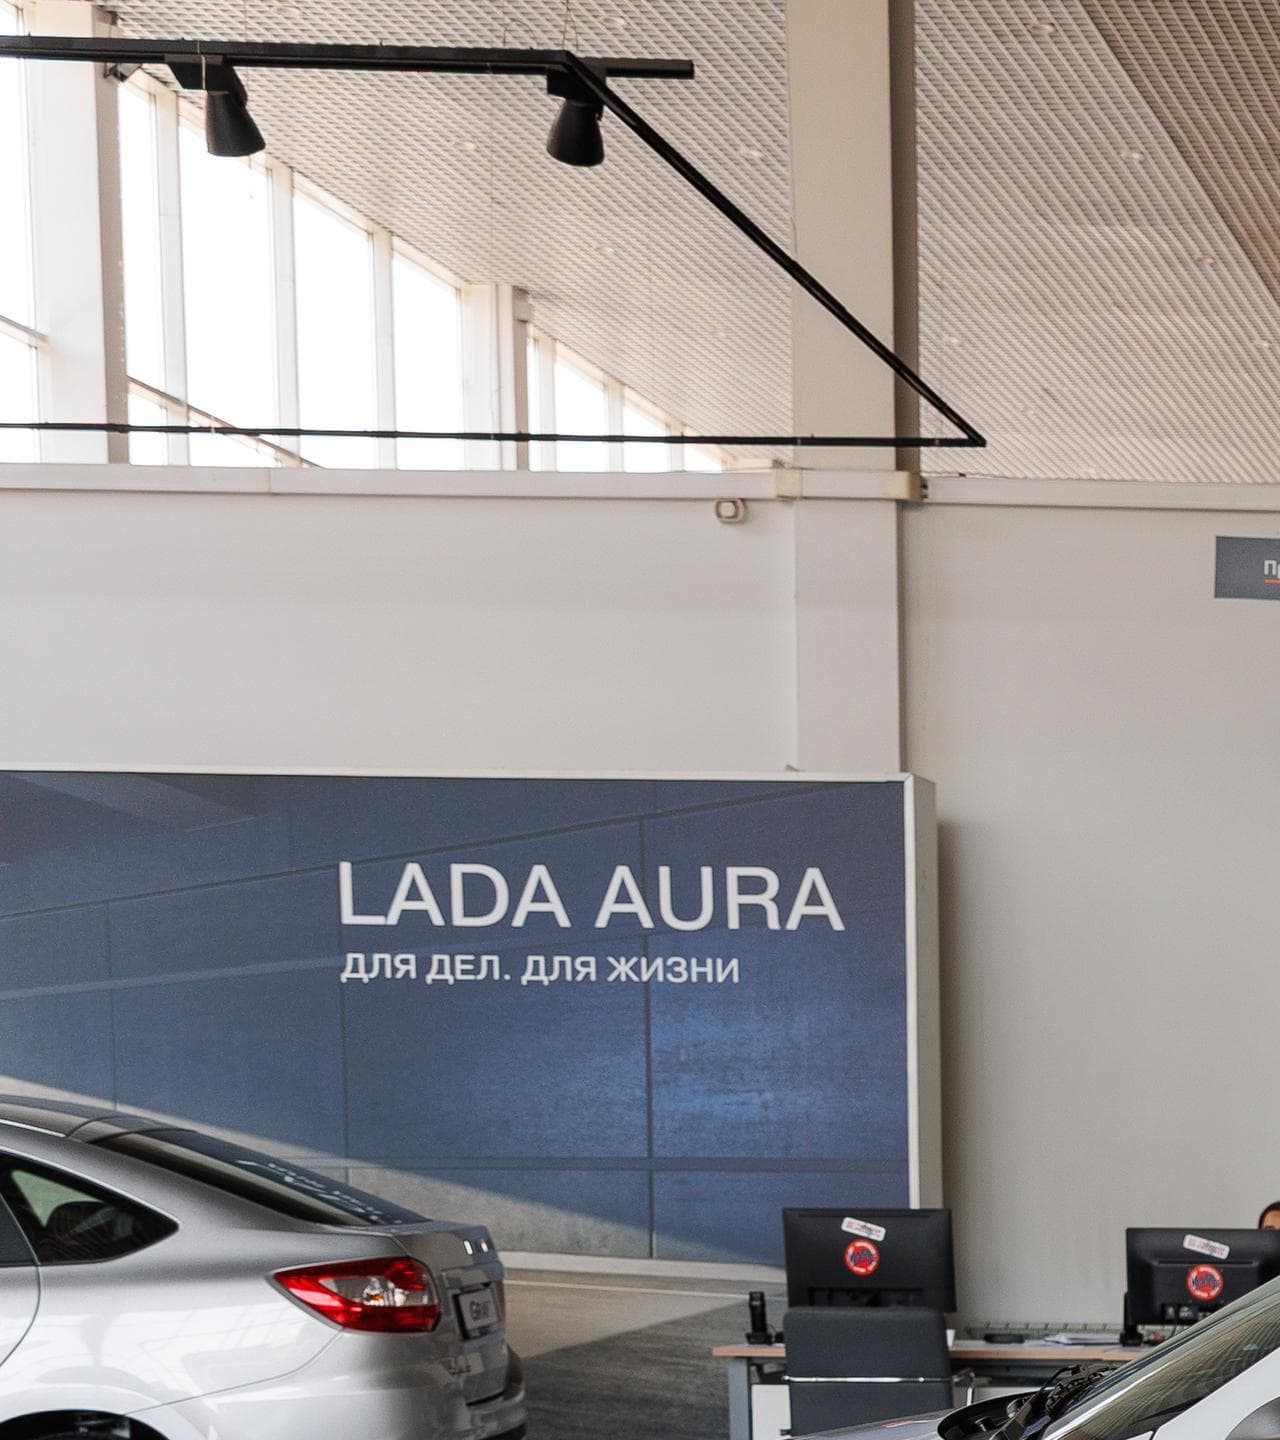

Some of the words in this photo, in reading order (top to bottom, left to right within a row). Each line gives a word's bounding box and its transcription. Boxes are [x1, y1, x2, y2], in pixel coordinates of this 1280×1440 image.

[339, 861, 572, 928] LADA
[594, 865, 846, 931] AURA
[340, 952, 417, 984] ДЛЯ
[425, 954, 511, 985] ДЕЛ.
[520, 955, 597, 986] ДЛЯ
[607, 956, 739, 983] ЖИЗНИ
